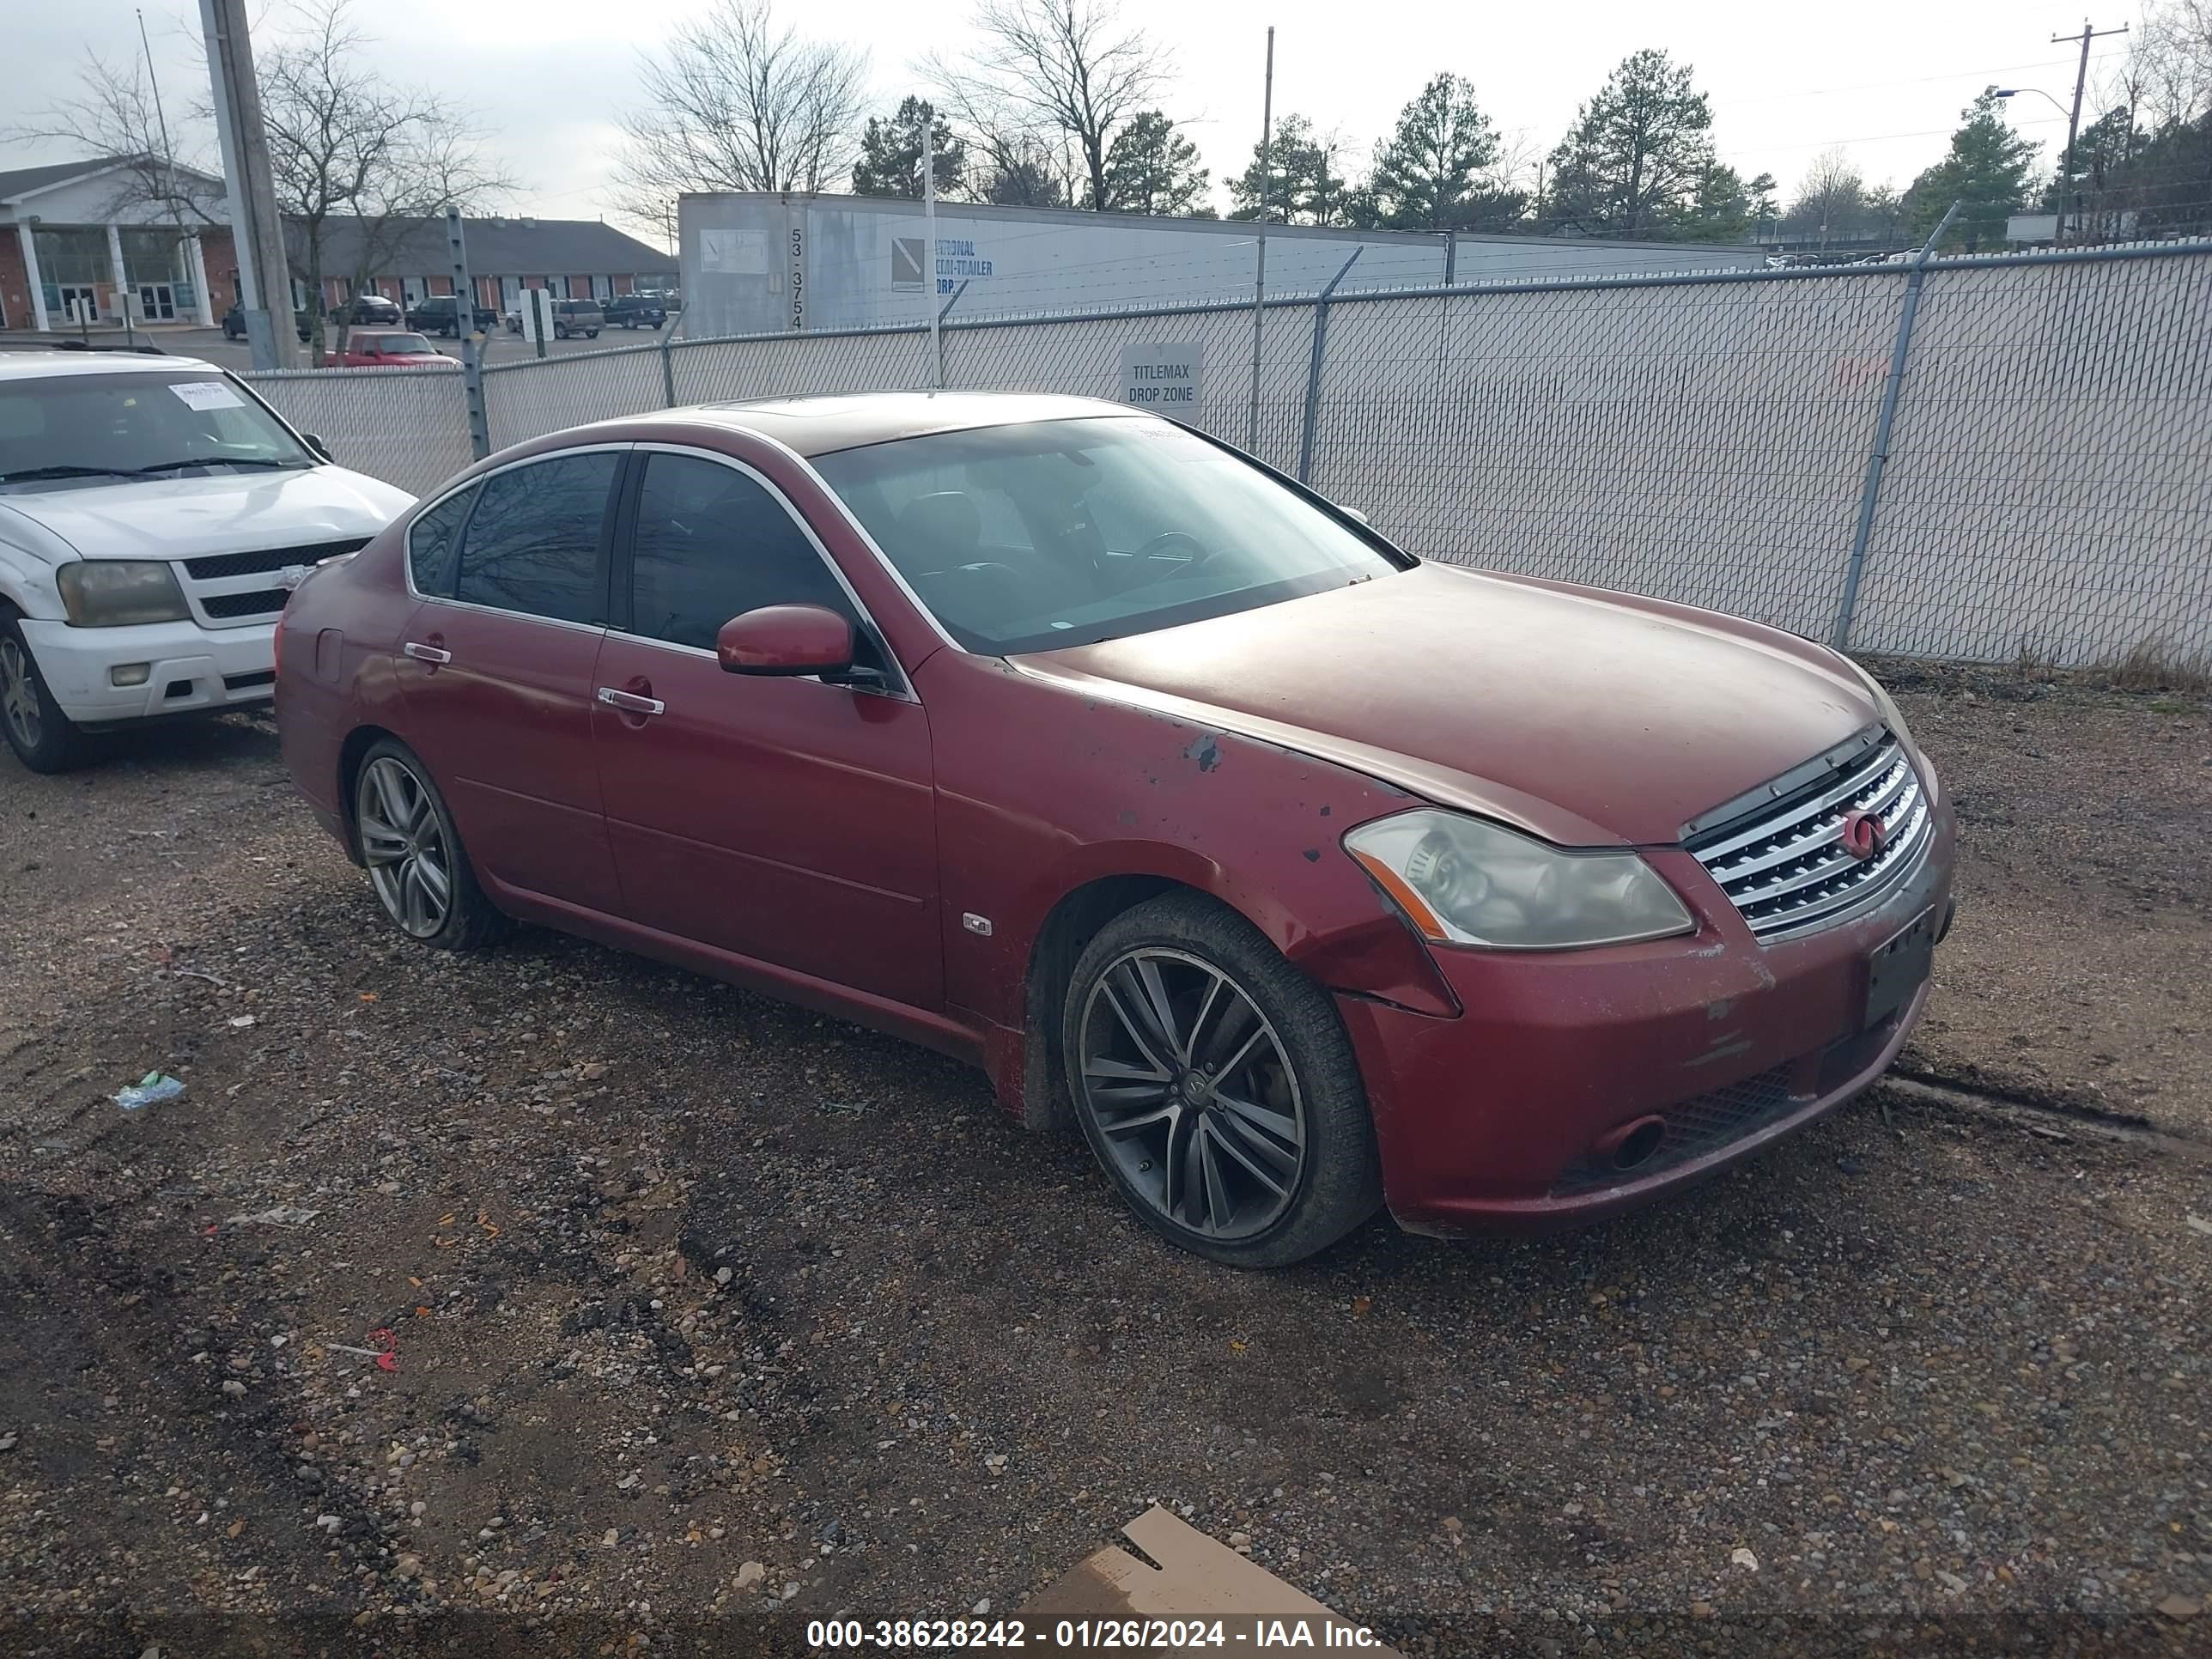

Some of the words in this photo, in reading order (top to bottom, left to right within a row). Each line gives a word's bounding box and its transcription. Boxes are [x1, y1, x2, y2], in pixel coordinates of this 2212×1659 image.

[934, 240, 975, 256] ATIONAL
[936, 259, 992, 276] EMI-TRAILER
[792, 228, 802, 329] 53-3754
[937, 278, 955, 294] ORP.
[1133, 364, 1189, 380] TITLEMAX
[1129, 387, 1159, 402] DROP
[1163, 386, 1193, 401] ZONE
